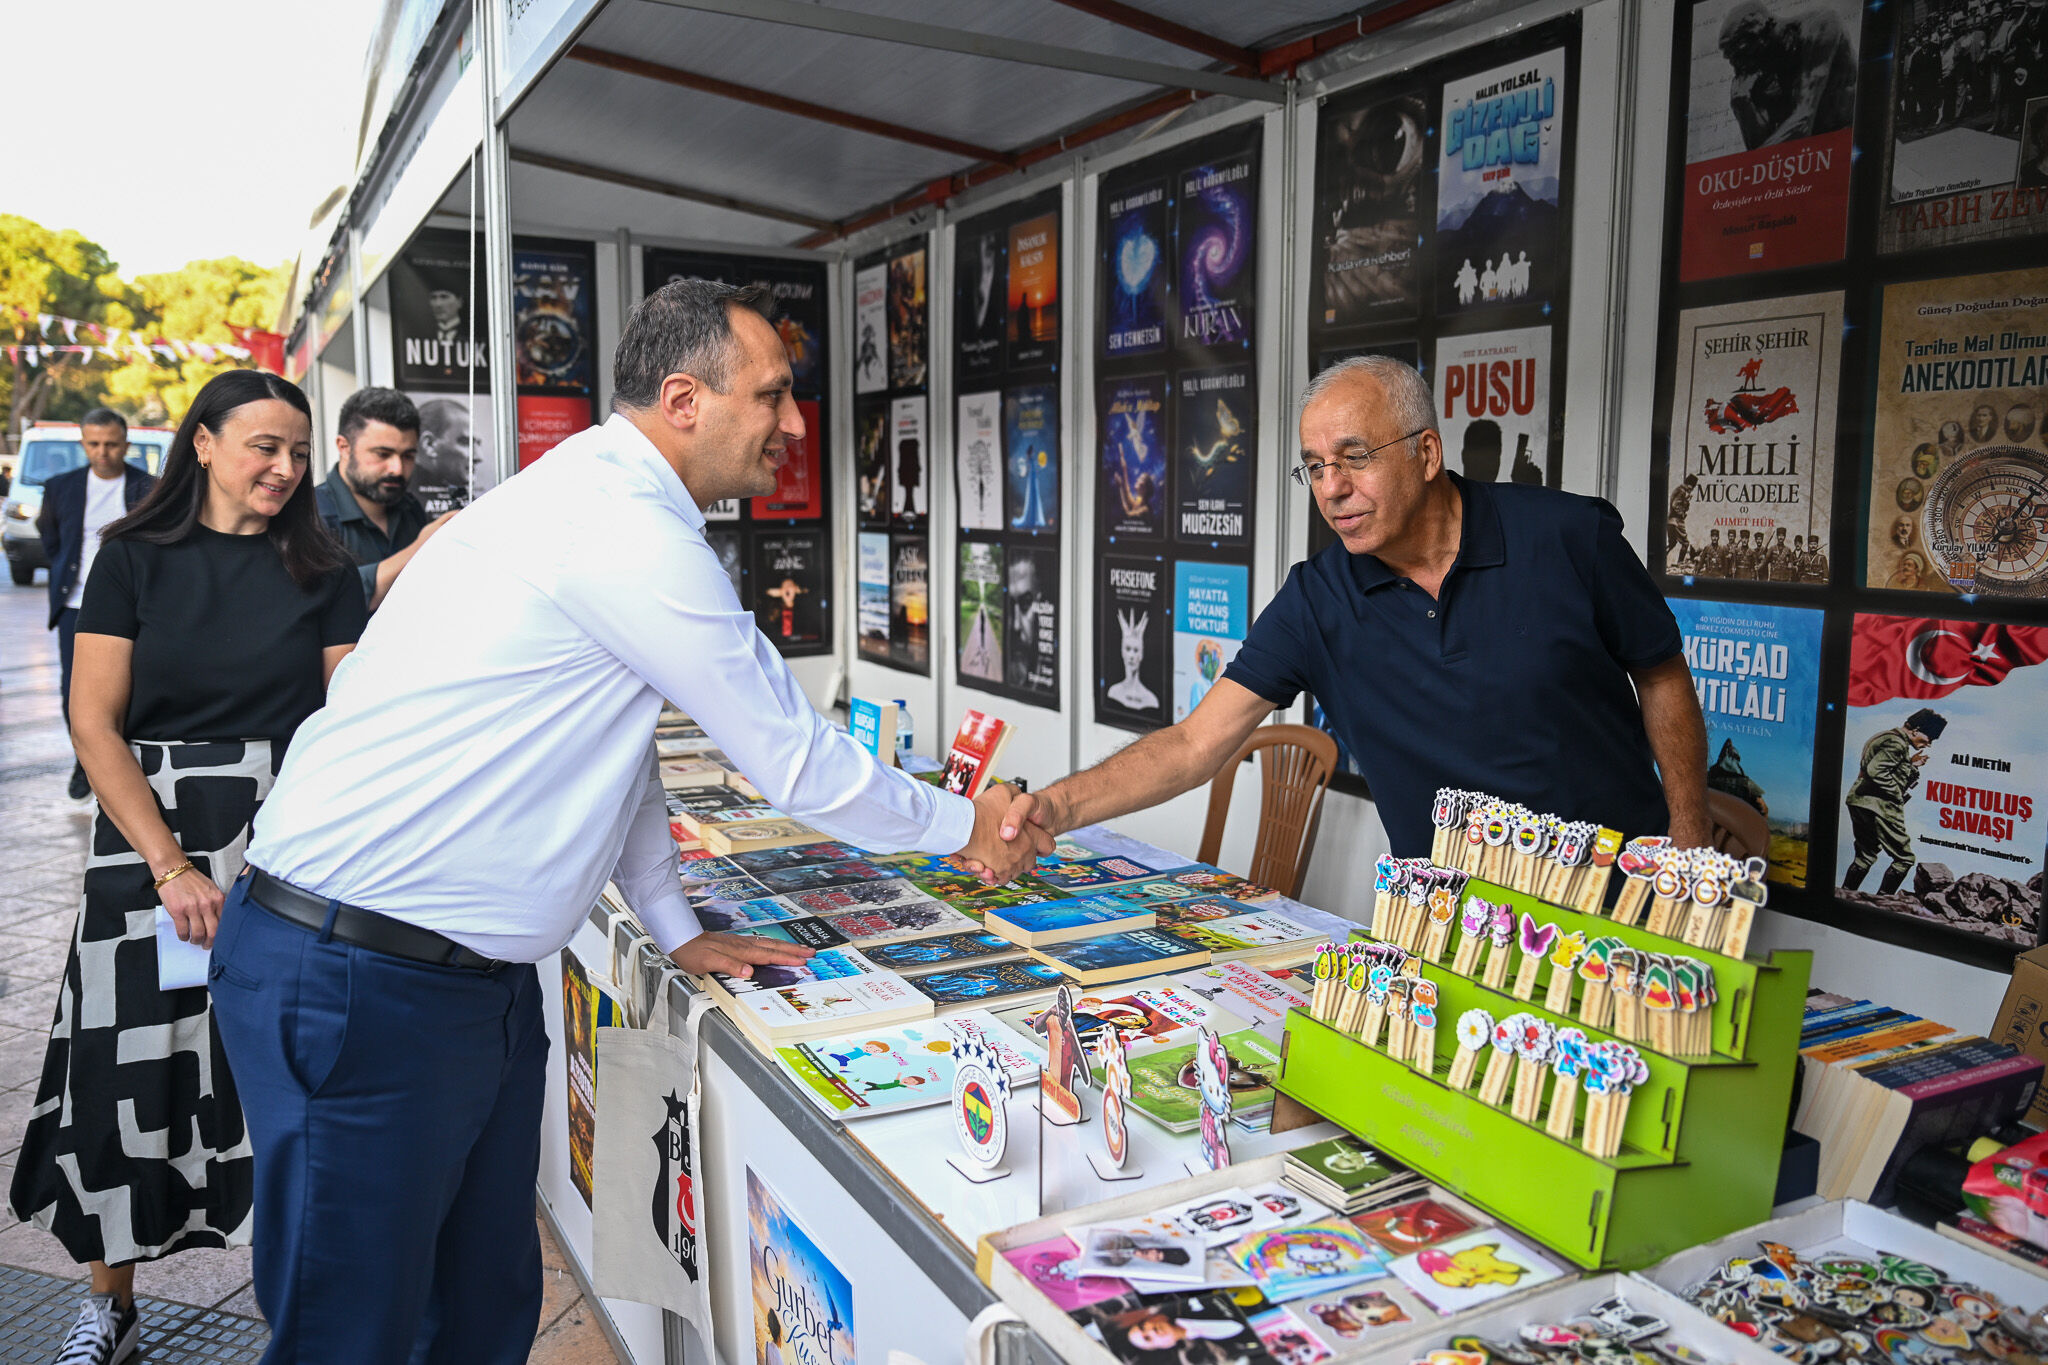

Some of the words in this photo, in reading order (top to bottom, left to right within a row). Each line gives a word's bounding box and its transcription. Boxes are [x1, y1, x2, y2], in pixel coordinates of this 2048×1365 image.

[1475, 82, 1499, 101] HALUK
[1500, 68, 1541, 92] YOLSAL
[1698, 147, 1833, 196] OKU-DÜŞÜN
[1896, 194, 1983, 234] TARİH
[1917, 304, 1953, 316] Güneş
[1955, 299, 2009, 313] Doğudan
[405, 336, 489, 368] NUTUK
[1704, 332, 1751, 360] ŞEHİR
[1754, 327, 1809, 356] ŞEHİR
[1905, 337, 1959, 358] Tarihe
[1964, 333, 1994, 354] Mal
[2000, 330, 2048, 351] Olmu
[1443, 358, 1536, 420] PUSU
[1696, 434, 1800, 477] MİLLİ
[1695, 479, 1800, 504] MÜCADELE
[1181, 512, 1243, 537] MUCİZESİN
[1713, 517, 1750, 528] AHMET
[1751, 515, 1775, 528] HÜR
[1110, 568, 1157, 591] PERSEFONE
[1188, 587, 1229, 604] HAYATTA
[1188, 601, 1229, 620] RÖVANŞ
[1188, 618, 1229, 634] YOKTUR
[1684, 635, 1789, 681] KÜRŞAD
[1950, 752, 1970, 766] ALİ
[1971, 755, 2011, 773] METİN
[1925, 780, 2034, 823] KURTULUŞ
[1939, 806, 2014, 844] SAVAŞI
[1128, 931, 1187, 955] ZEON
[1223, 963, 1264, 984] BÜYÜK
[1136, 990, 1167, 1009] Çocuk
[1226, 975, 1278, 1002] ÇİFTLİĞİ
